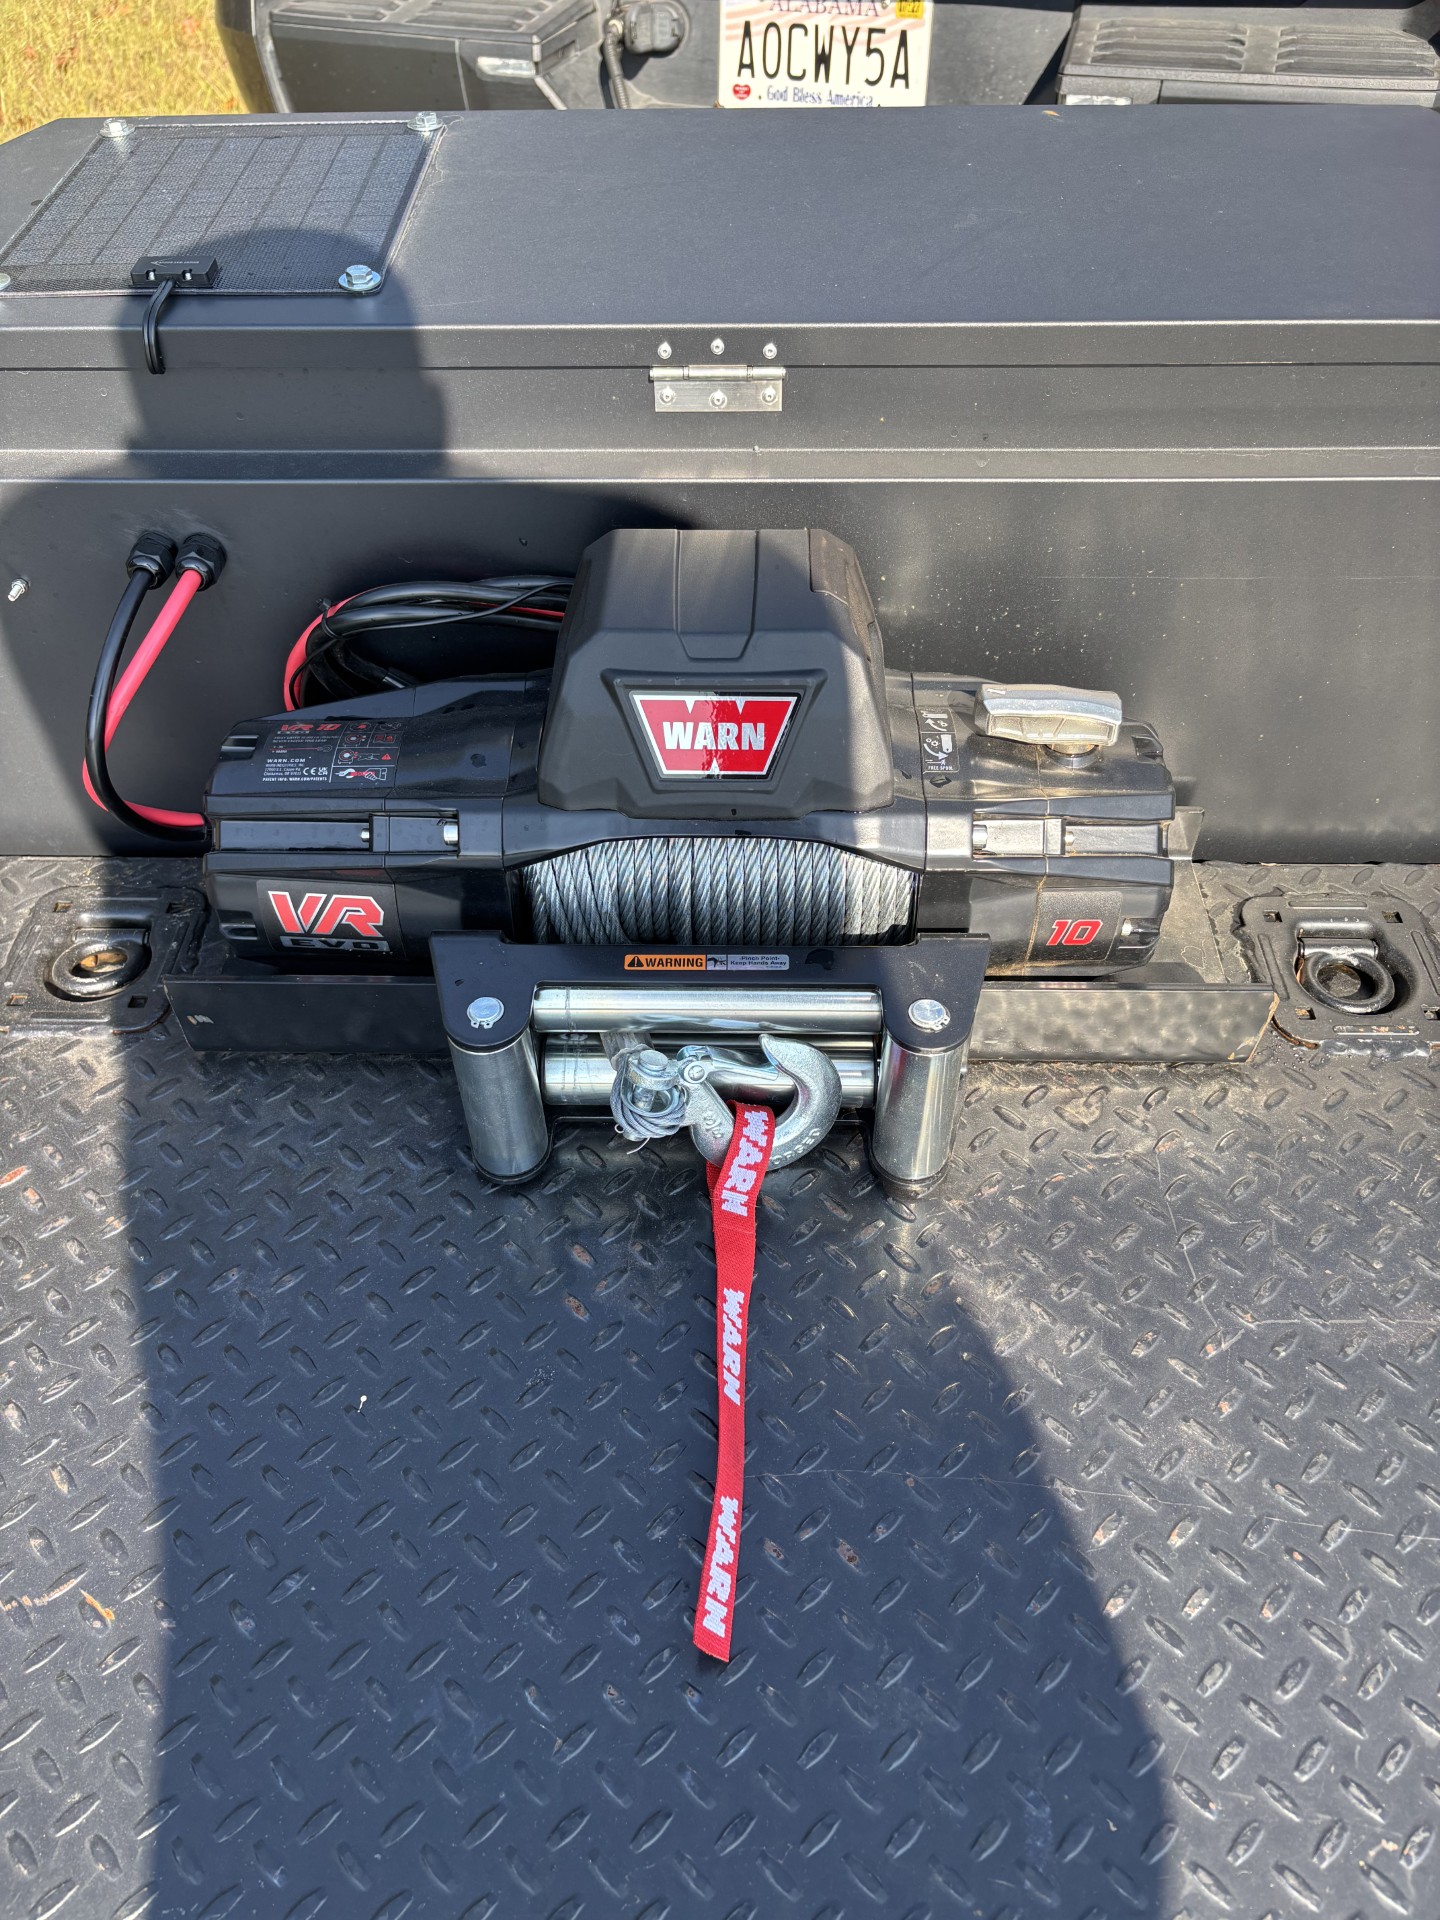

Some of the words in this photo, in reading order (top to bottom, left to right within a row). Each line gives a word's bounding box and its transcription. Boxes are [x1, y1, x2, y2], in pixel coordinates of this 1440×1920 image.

[769, 0, 880, 17] ALABAMA
[767, 85, 789, 102] God
[793, 86, 822, 104] Bless
[827, 90, 873, 107] America
[316, 723, 342, 731] 10
[662, 721, 765, 750] WARN
[268, 891, 384, 937] VR
[287, 937, 383, 950] EVO
[1046, 919, 1103, 945] 10
[645, 957, 703, 968] WARNING
[721, 1110, 768, 1217] WARN
[722, 1287, 745, 1406] WARN
[702, 1494, 739, 1638] WARN
